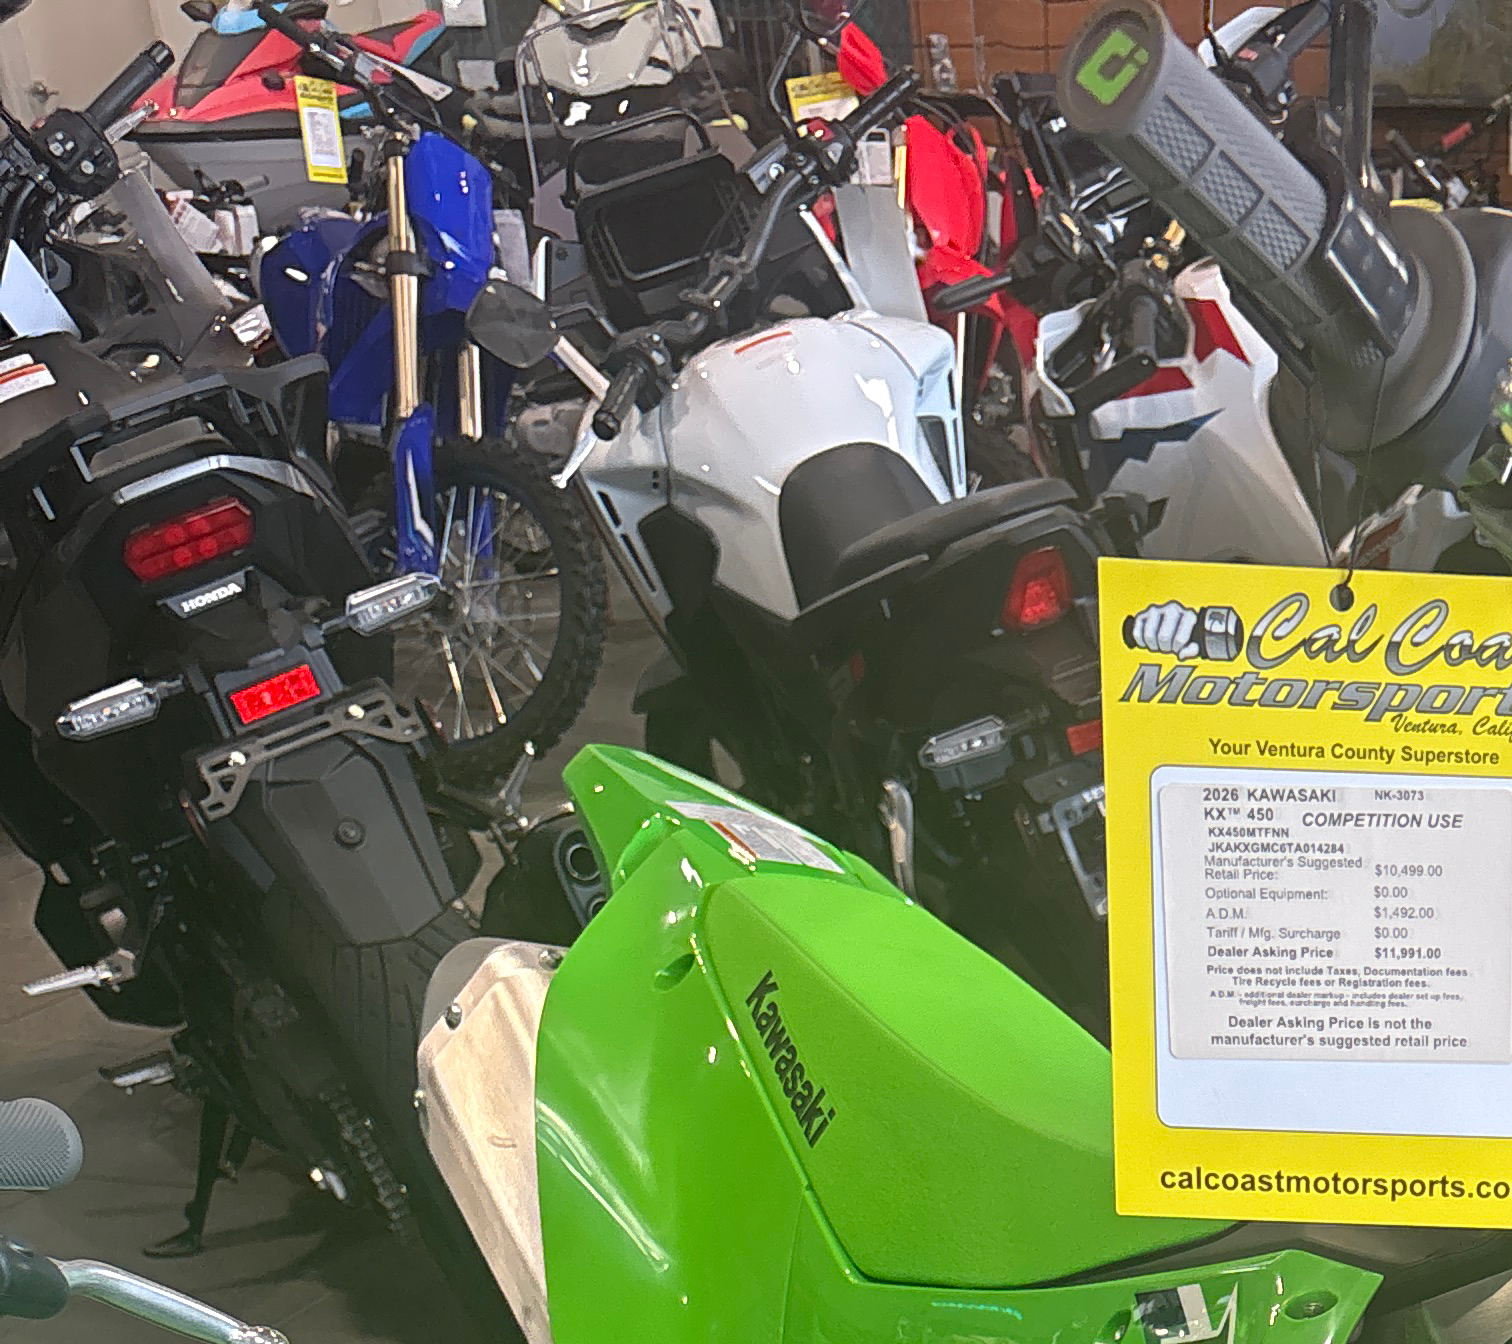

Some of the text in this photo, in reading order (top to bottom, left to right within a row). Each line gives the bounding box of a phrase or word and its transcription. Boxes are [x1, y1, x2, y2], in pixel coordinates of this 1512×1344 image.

[180, 582, 243, 613] HONDA
[1244, 591, 1382, 671] Cal
[1208, 738, 1500, 766] Your Ventura County Superstore
[1202, 787, 1425, 803] 2026 KAWASAKI NK-3073
[1246, 807, 1275, 821] 450
[1302, 812, 1464, 829] COMPETITION USE
[1204, 855, 1363, 871] Manufacturer's Suggested
[1374, 863, 1443, 878] $10,499.00
[1204, 868, 1240, 880] Retail
[1205, 886, 1329, 902] Optional Equipment:
[1373, 885, 1409, 899] $0.00
[1373, 905, 1435, 920] $1,492.00
[1206, 926, 1240, 940] Tariff
[1278, 927, 1341, 942] Surcharge
[1373, 925, 1409, 940] $0.00
[1207, 945, 1334, 961] Dealer Asking Price
[1374, 946, 1442, 961] $11,991.00
[1206, 965, 1234, 976] Price
[1236, 966, 1263, 976] does
[1265, 966, 1283, 976] not
[1285, 966, 1324, 976] include
[1363, 966, 1443, 977] Documentation
[1232, 976, 1253, 987] Tire
[1255, 977, 1297, 989] Recycle
[1299, 977, 1322, 988] fees
[1324, 979, 1336, 988] or
[1338, 977, 1402, 990] Registration
[1228, 1015, 1433, 1031] Dealer Asking Price is not the
[1211, 1033, 1468, 1050] manufacturer's suggested retail price
[745, 968, 837, 1149] Kawasaki
